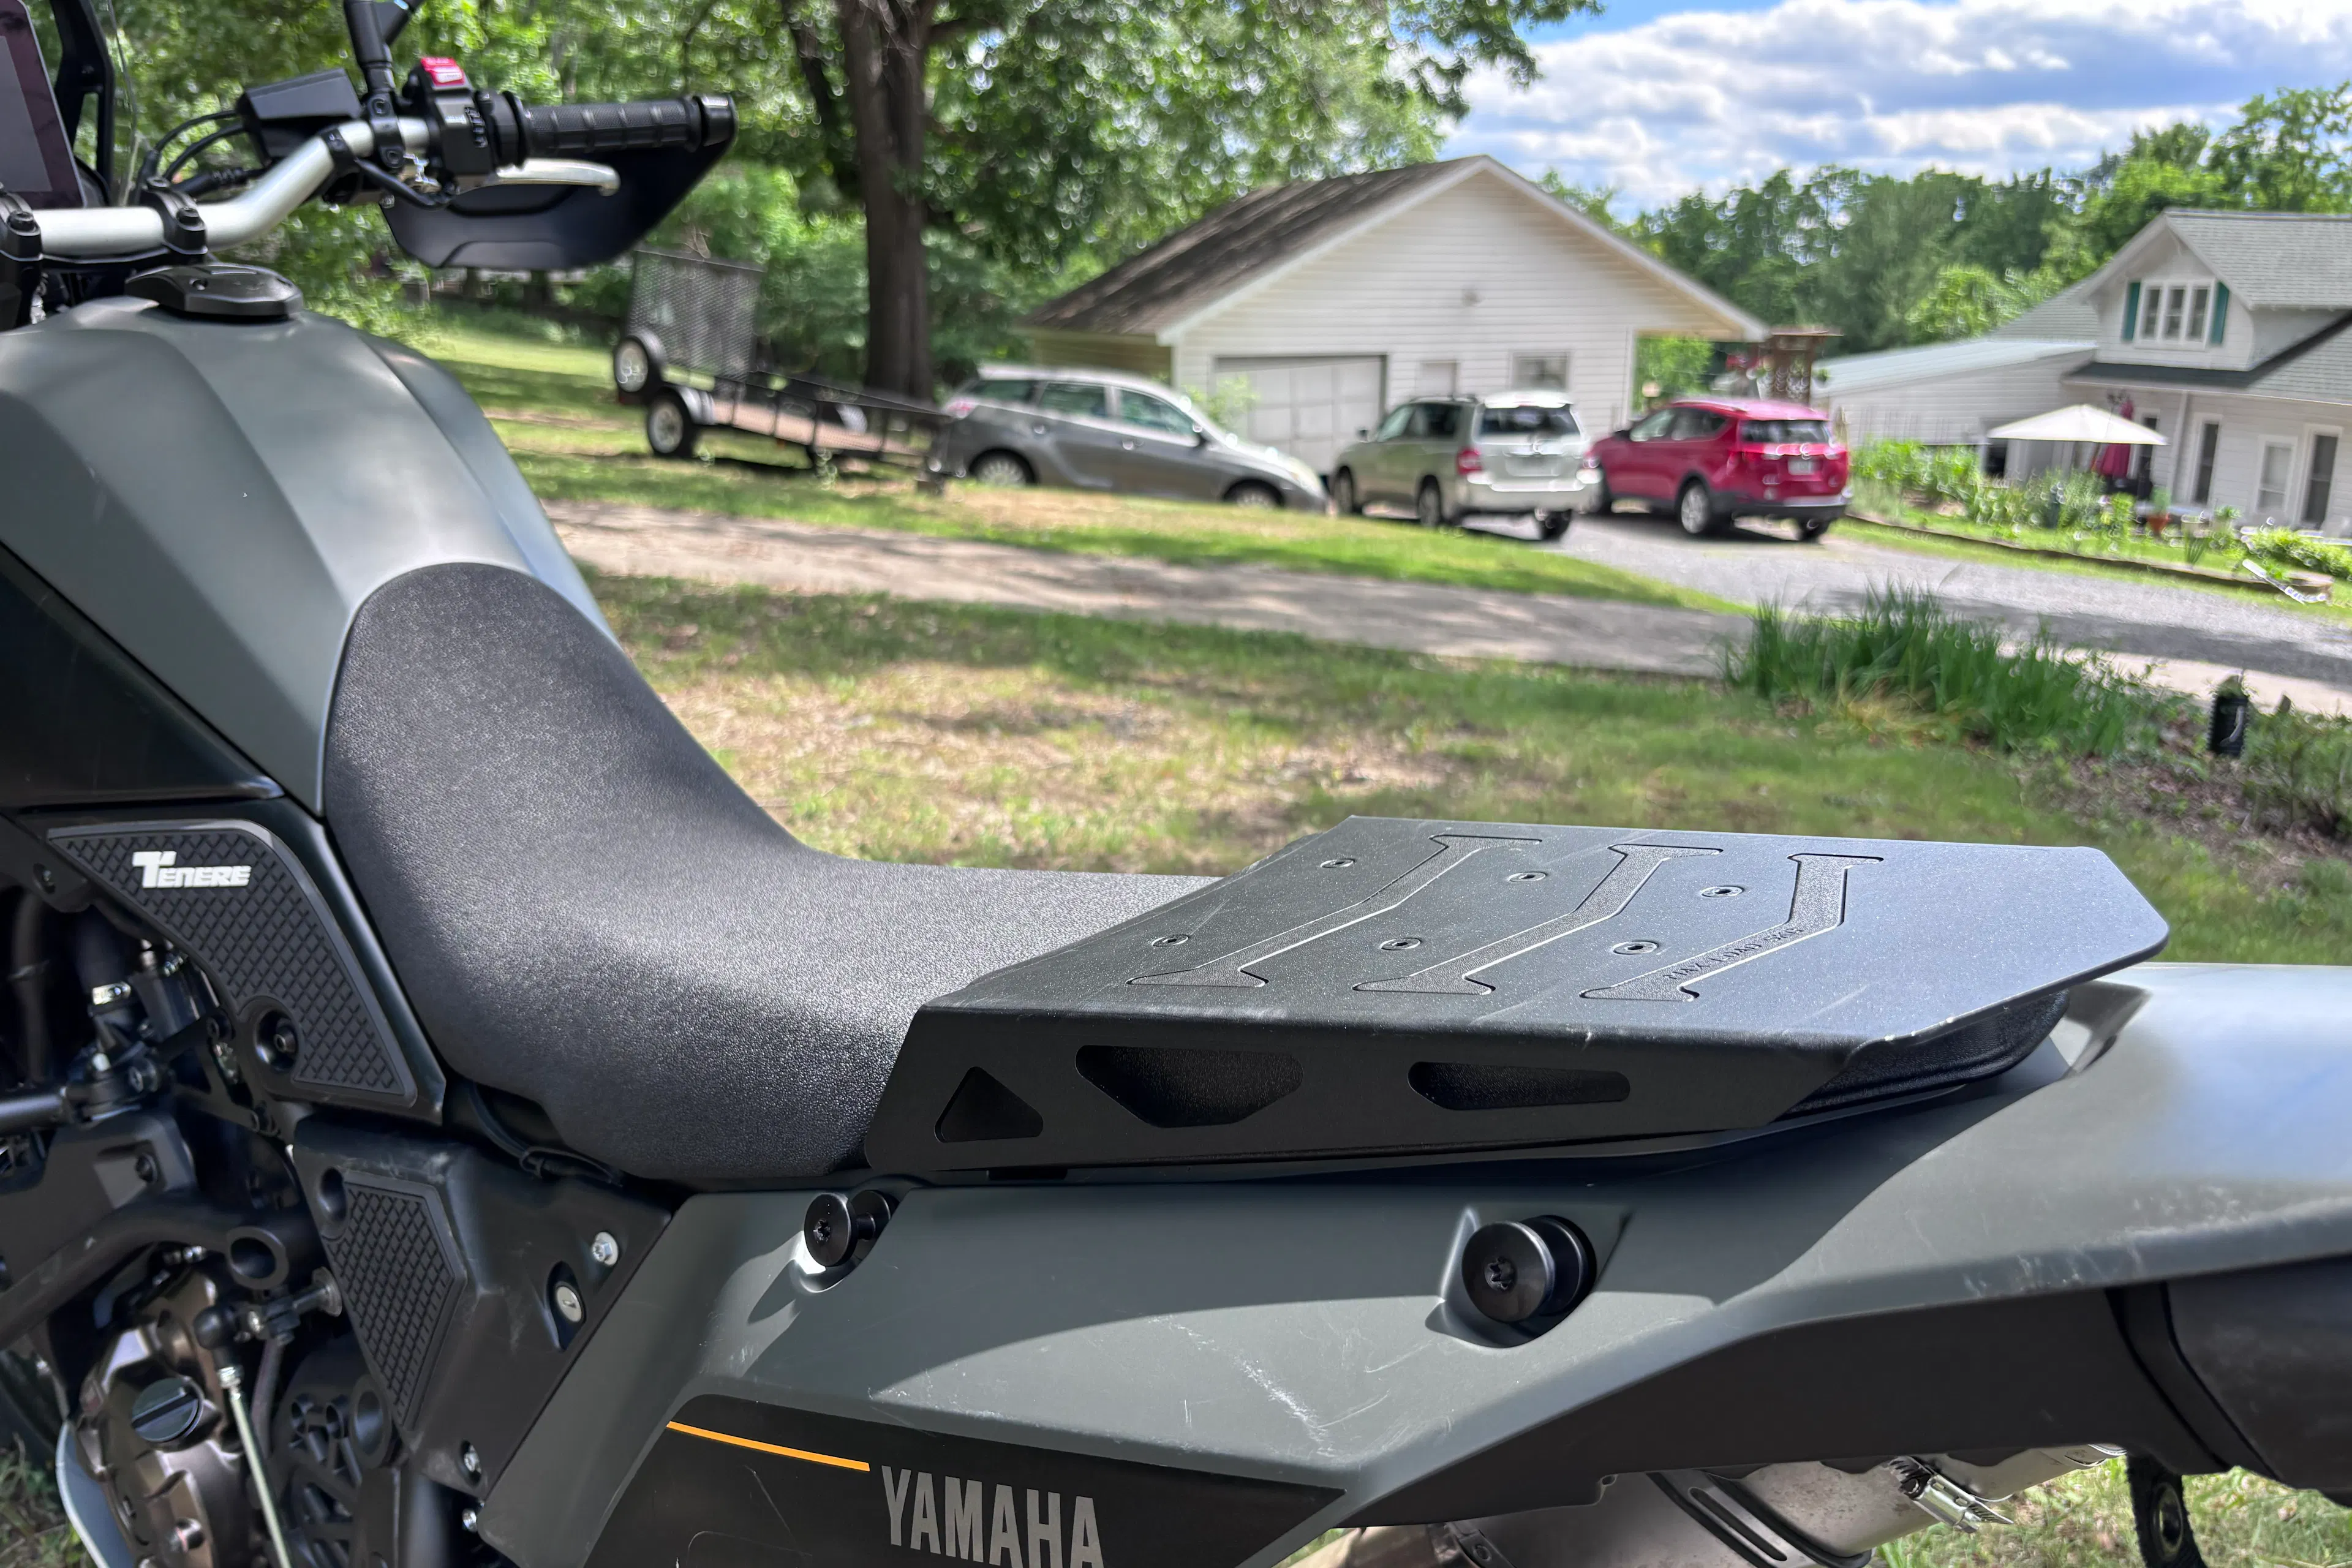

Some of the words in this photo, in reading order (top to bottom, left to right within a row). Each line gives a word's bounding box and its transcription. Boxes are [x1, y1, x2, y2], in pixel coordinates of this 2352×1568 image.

[1663, 963, 1711, 979] MAX
[1708, 943, 1762, 962] LOAD
[881, 1465, 1104, 1568] YAMAHA
